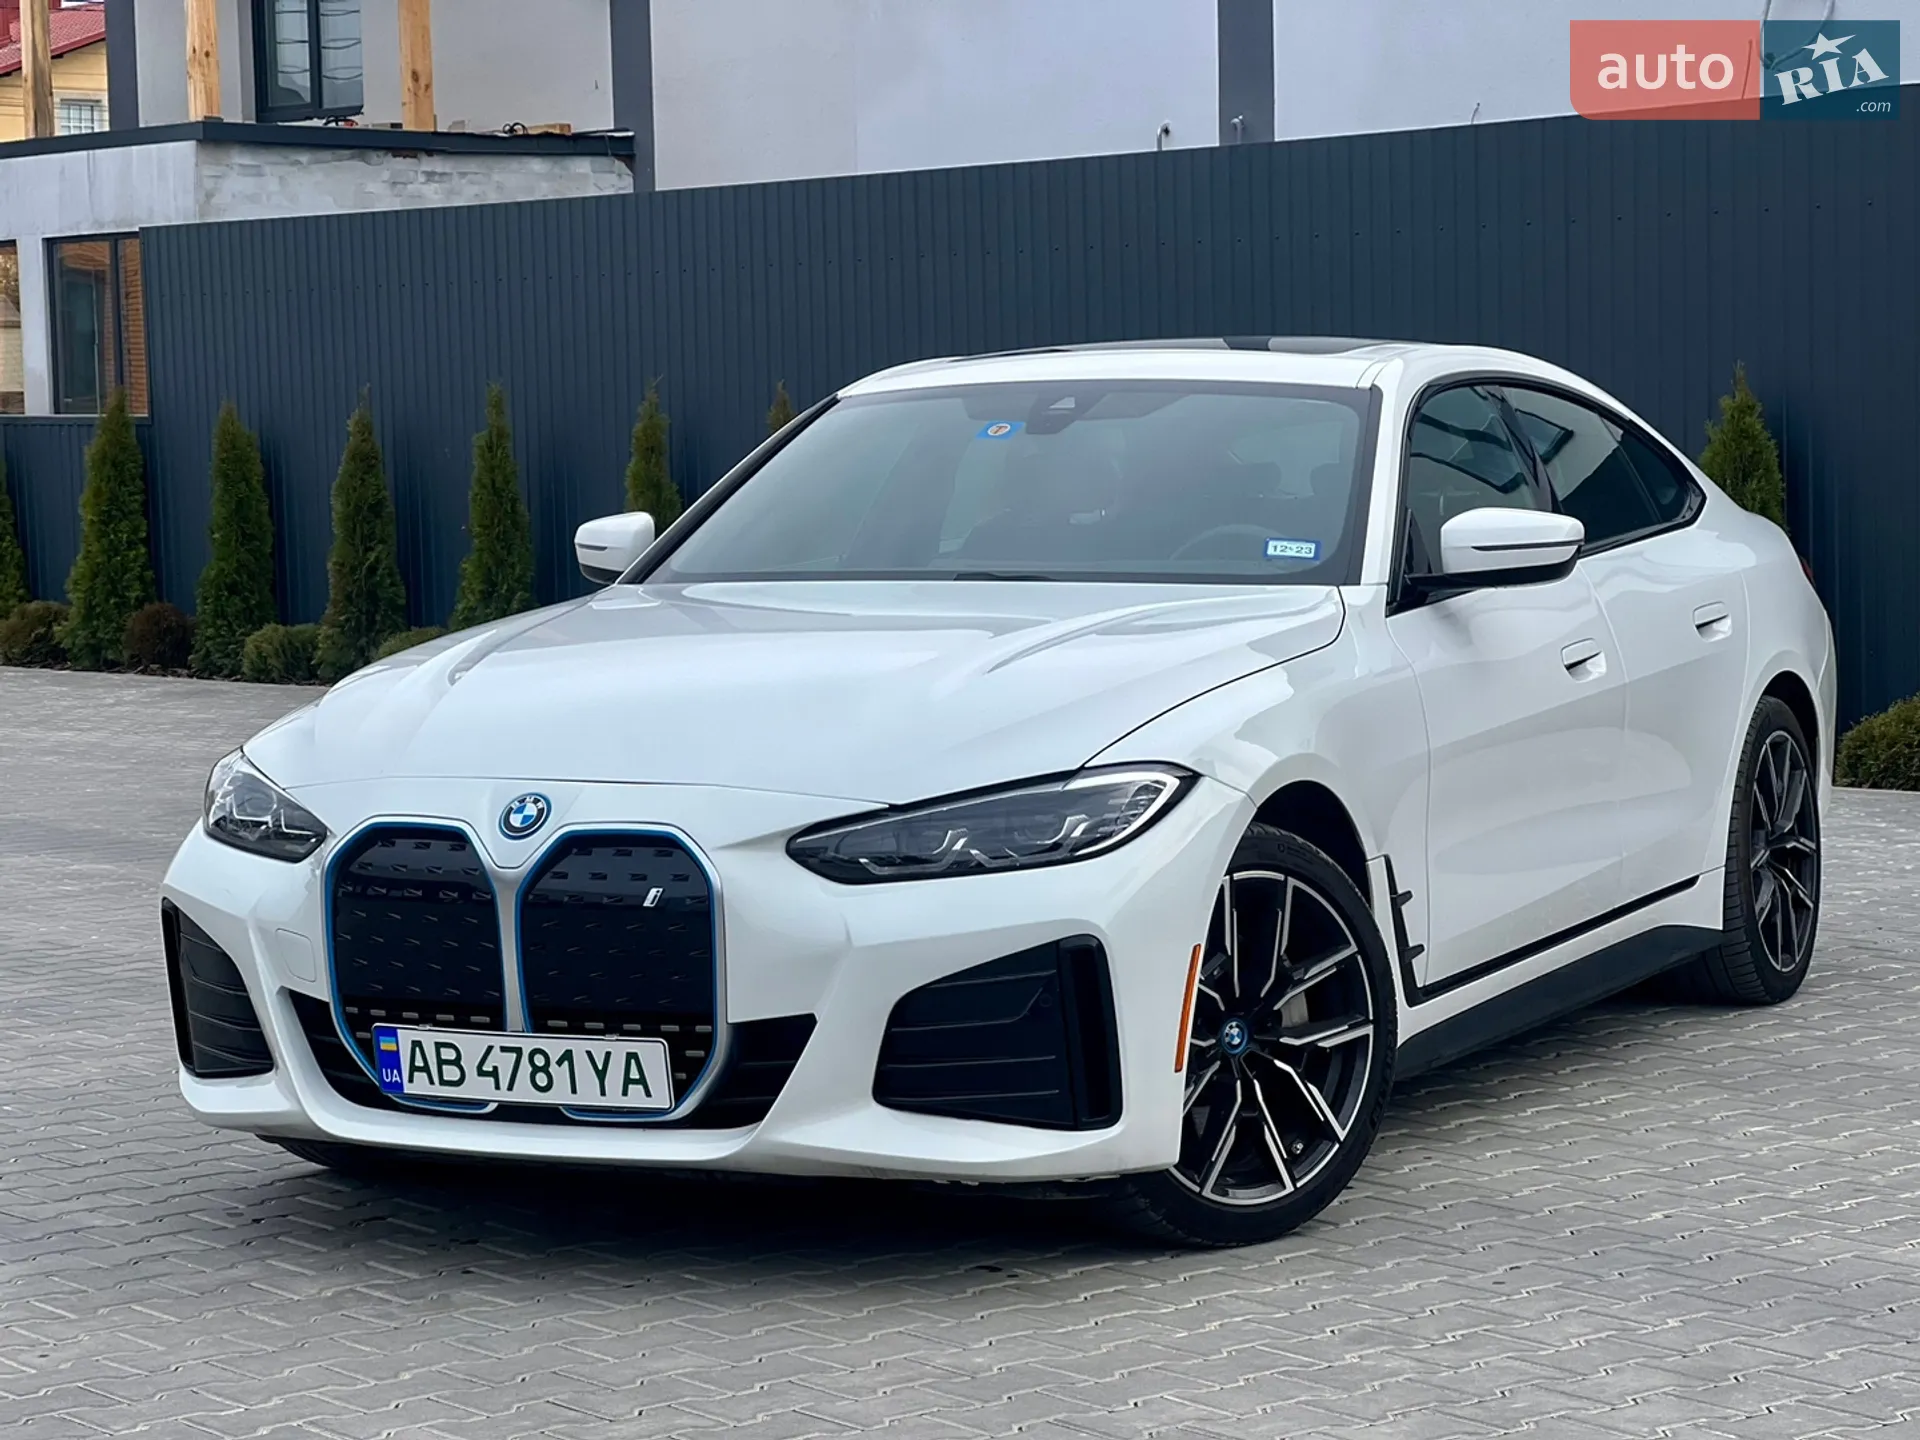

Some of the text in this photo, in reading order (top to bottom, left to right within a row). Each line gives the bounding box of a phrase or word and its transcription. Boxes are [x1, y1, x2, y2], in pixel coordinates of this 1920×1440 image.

[383, 1069, 401, 1083] UA
[407, 1040, 653, 1098] AB 4781 YA
